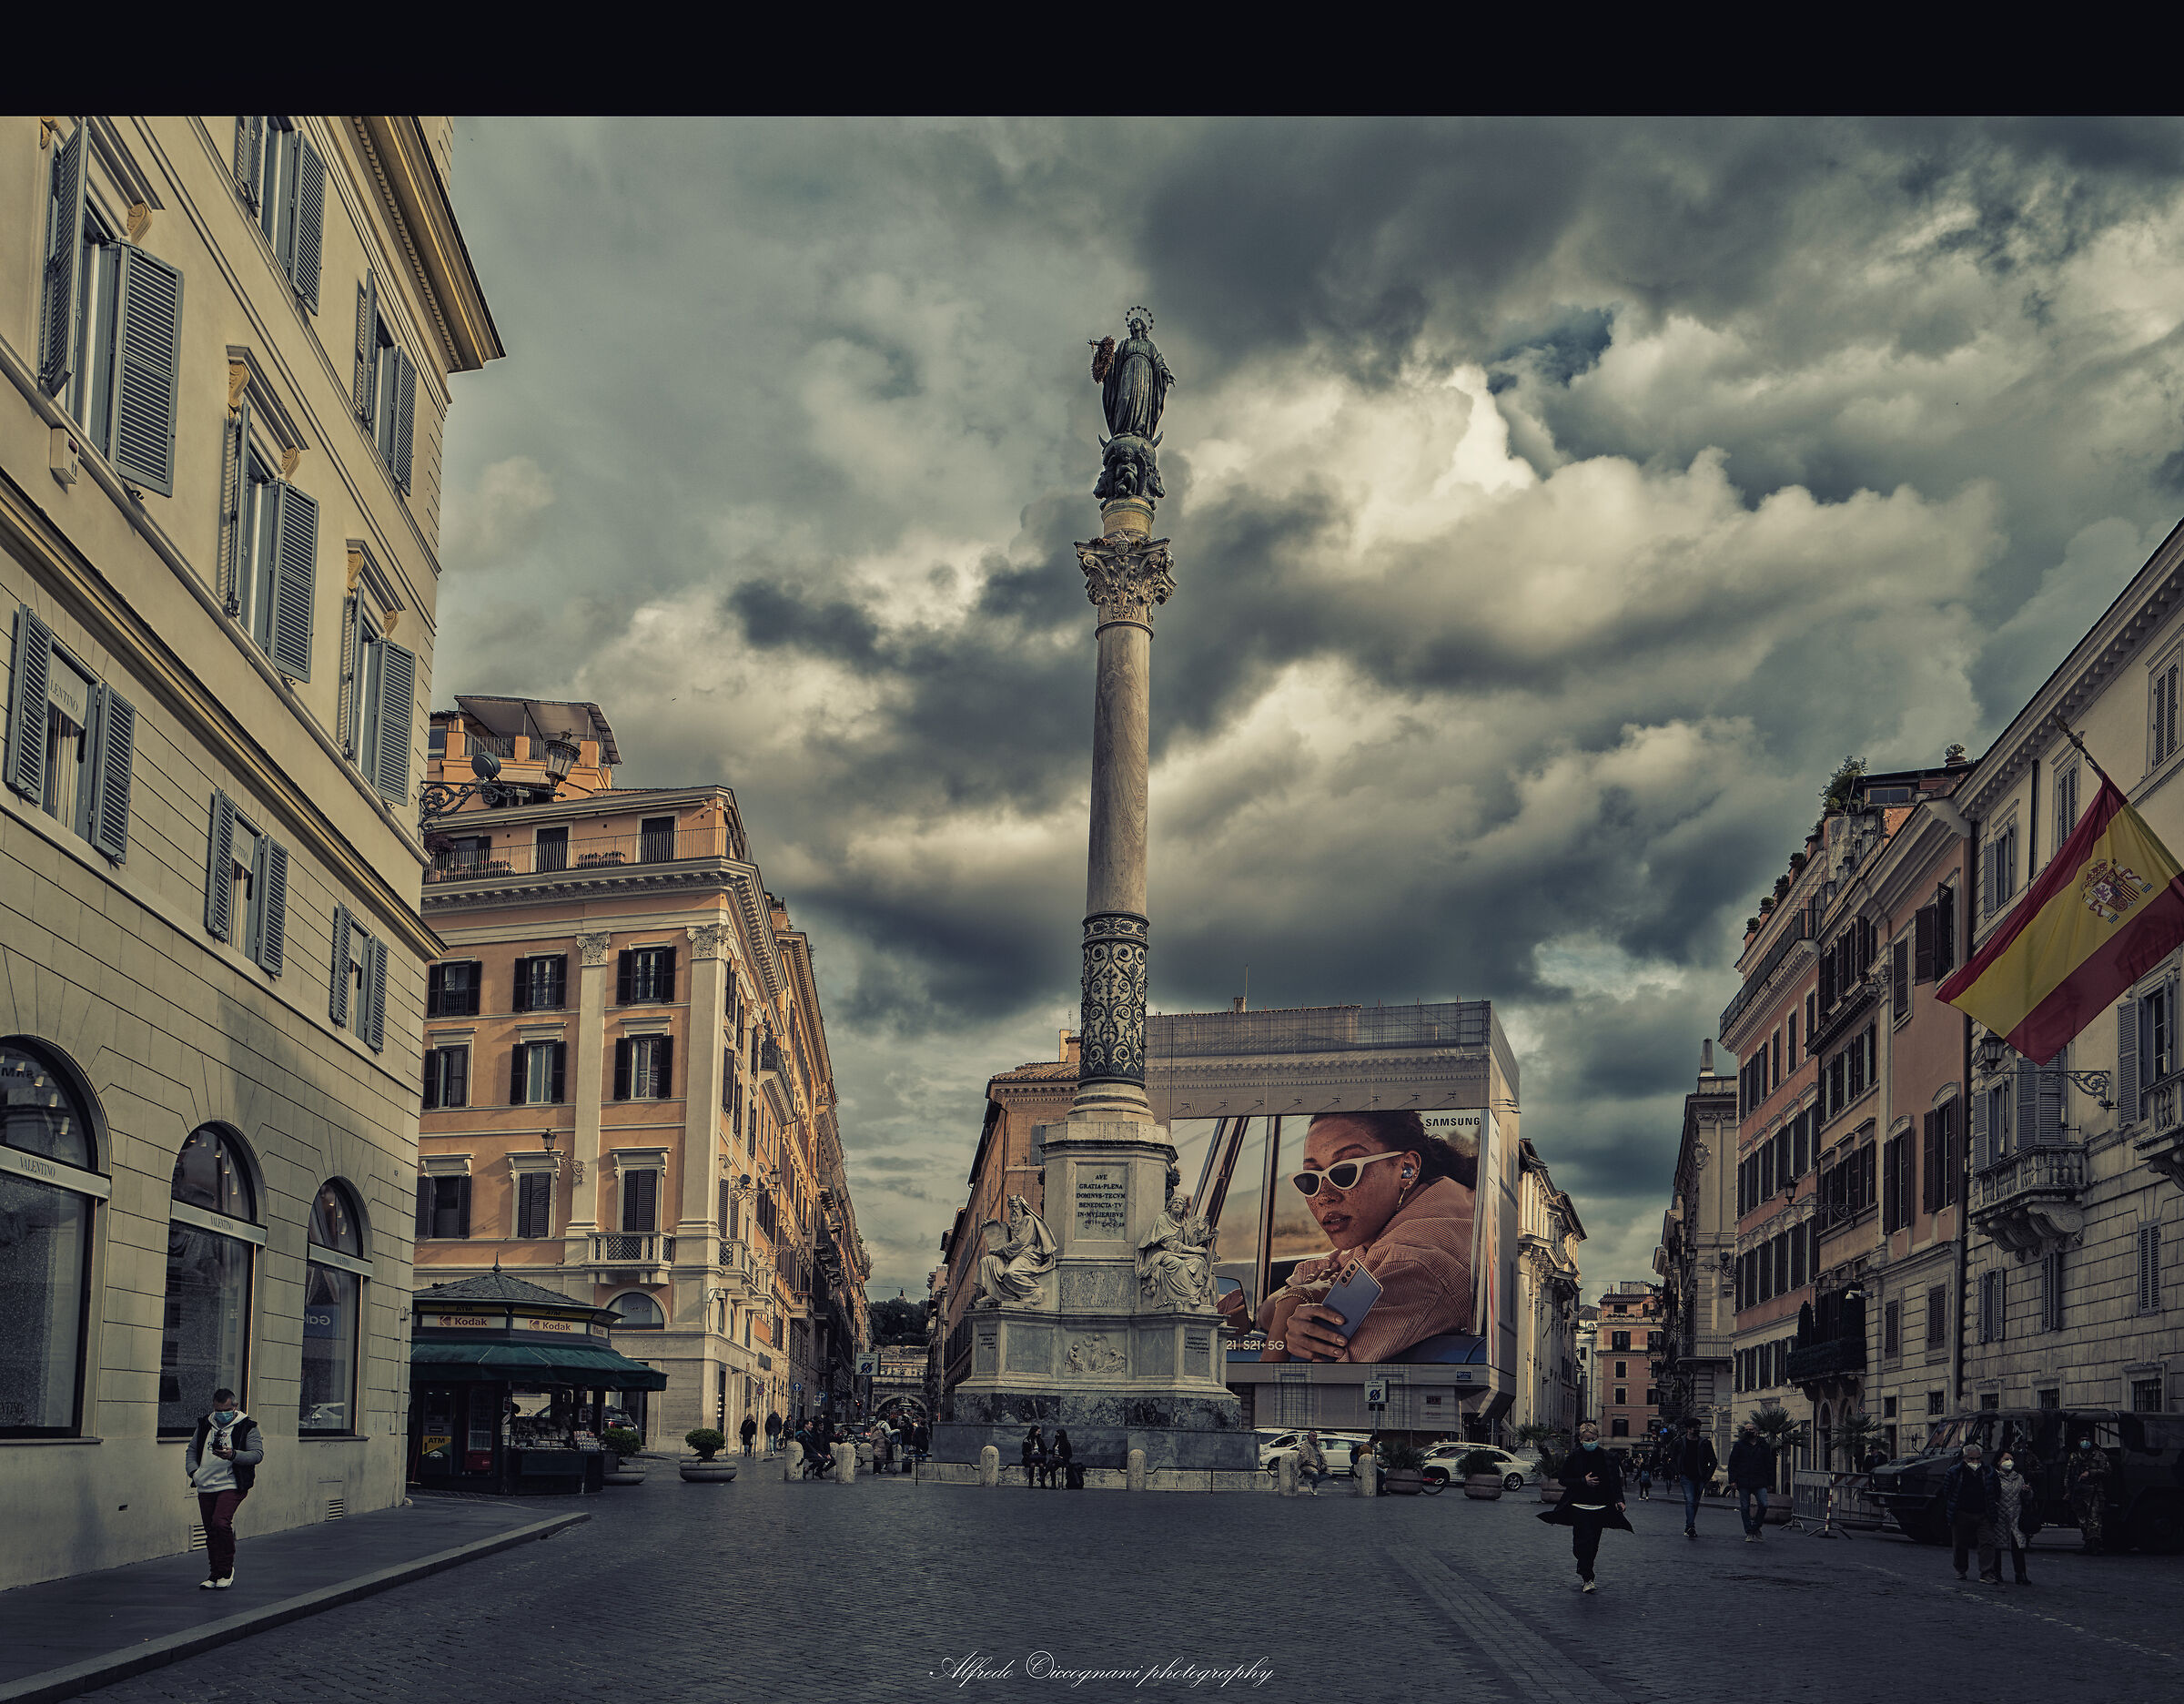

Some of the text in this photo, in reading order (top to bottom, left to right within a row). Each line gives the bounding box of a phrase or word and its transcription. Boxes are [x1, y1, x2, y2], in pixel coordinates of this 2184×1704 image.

[49, 678, 79, 713] LENTINO
[1425, 1117, 1481, 1127] SAMSUNG
[19, 1156, 56, 1178] VALENTINO
[455, 1317, 488, 1326] Kodak
[542, 1322, 571, 1331] Kodak
[1226, 1339, 1285, 1351] 21 S21+ 5G
